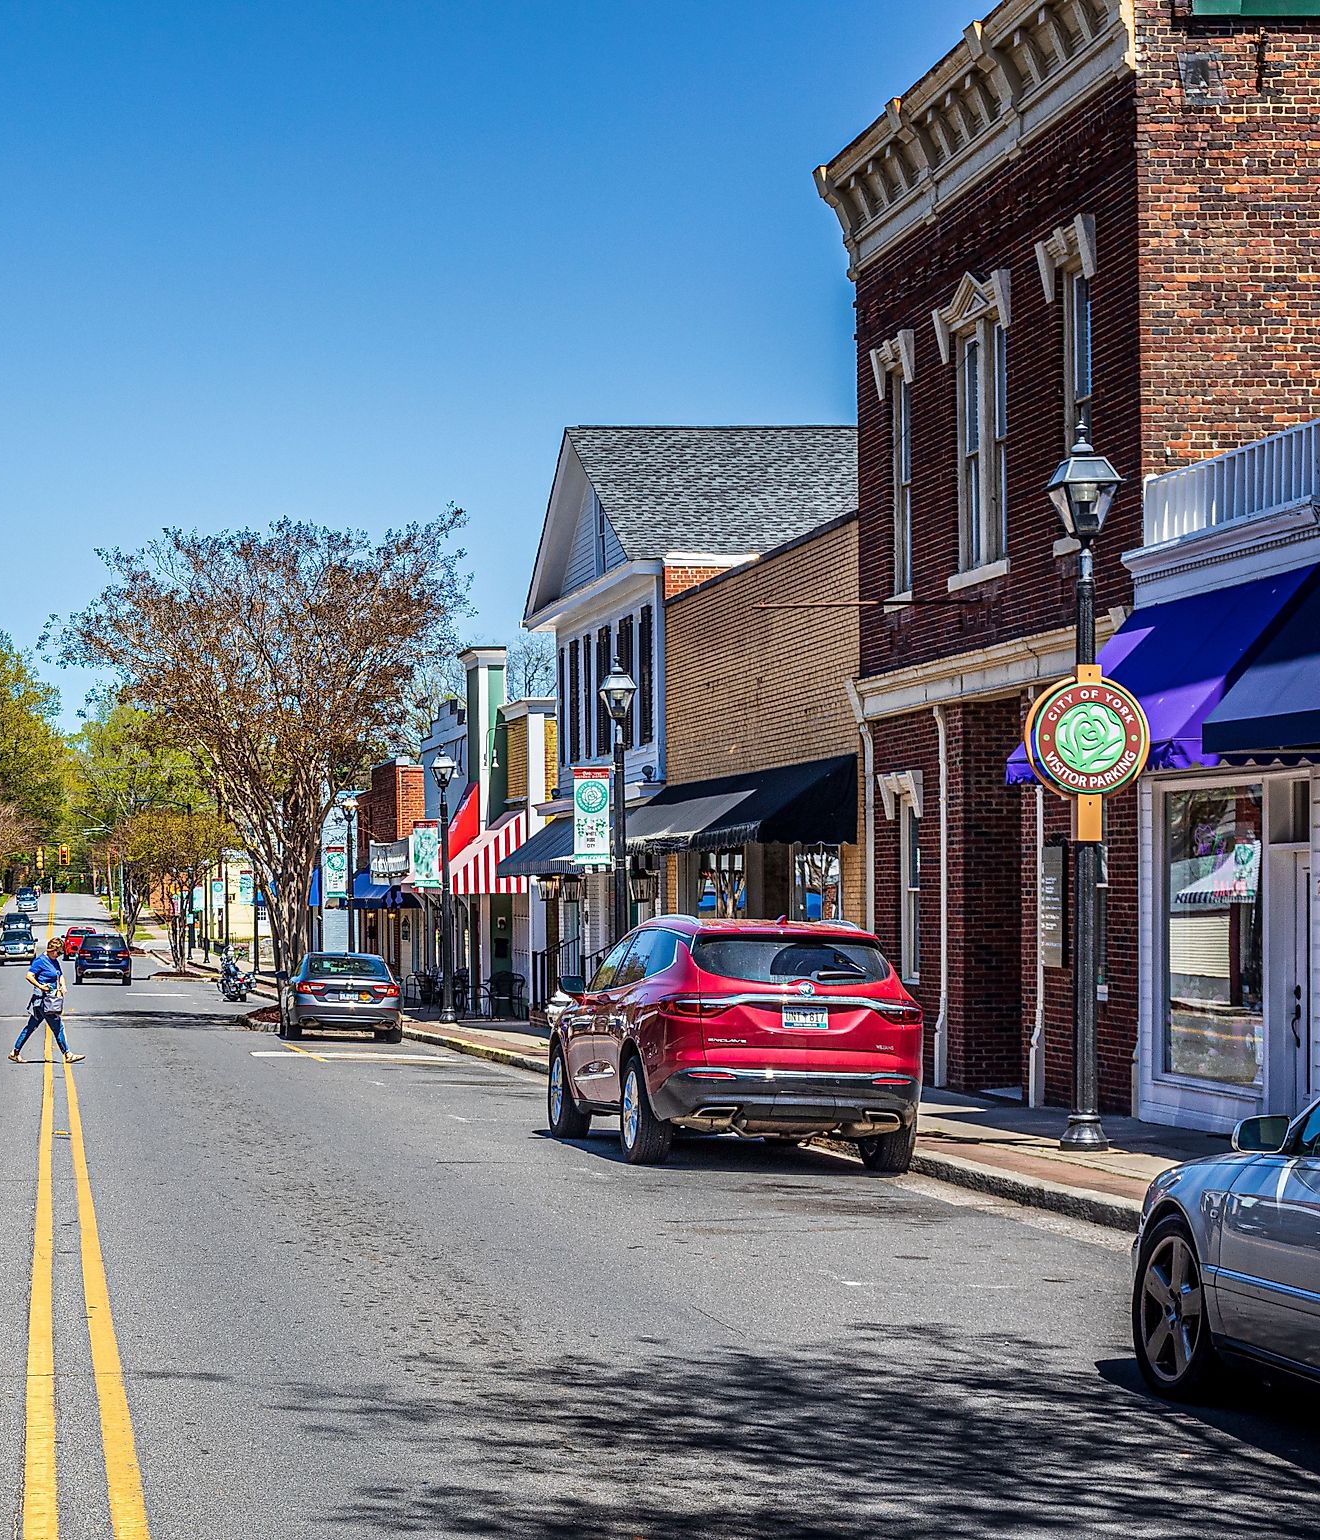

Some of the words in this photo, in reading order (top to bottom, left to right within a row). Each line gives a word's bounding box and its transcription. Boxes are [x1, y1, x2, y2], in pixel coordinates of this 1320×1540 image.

[1047, 694, 1074, 721] CITY
[1080, 689, 1099, 699] OF
[1105, 692, 1135, 725] YORK
[1045, 751, 1087, 787] VISITOR
[1089, 750, 1137, 788] PARKING
